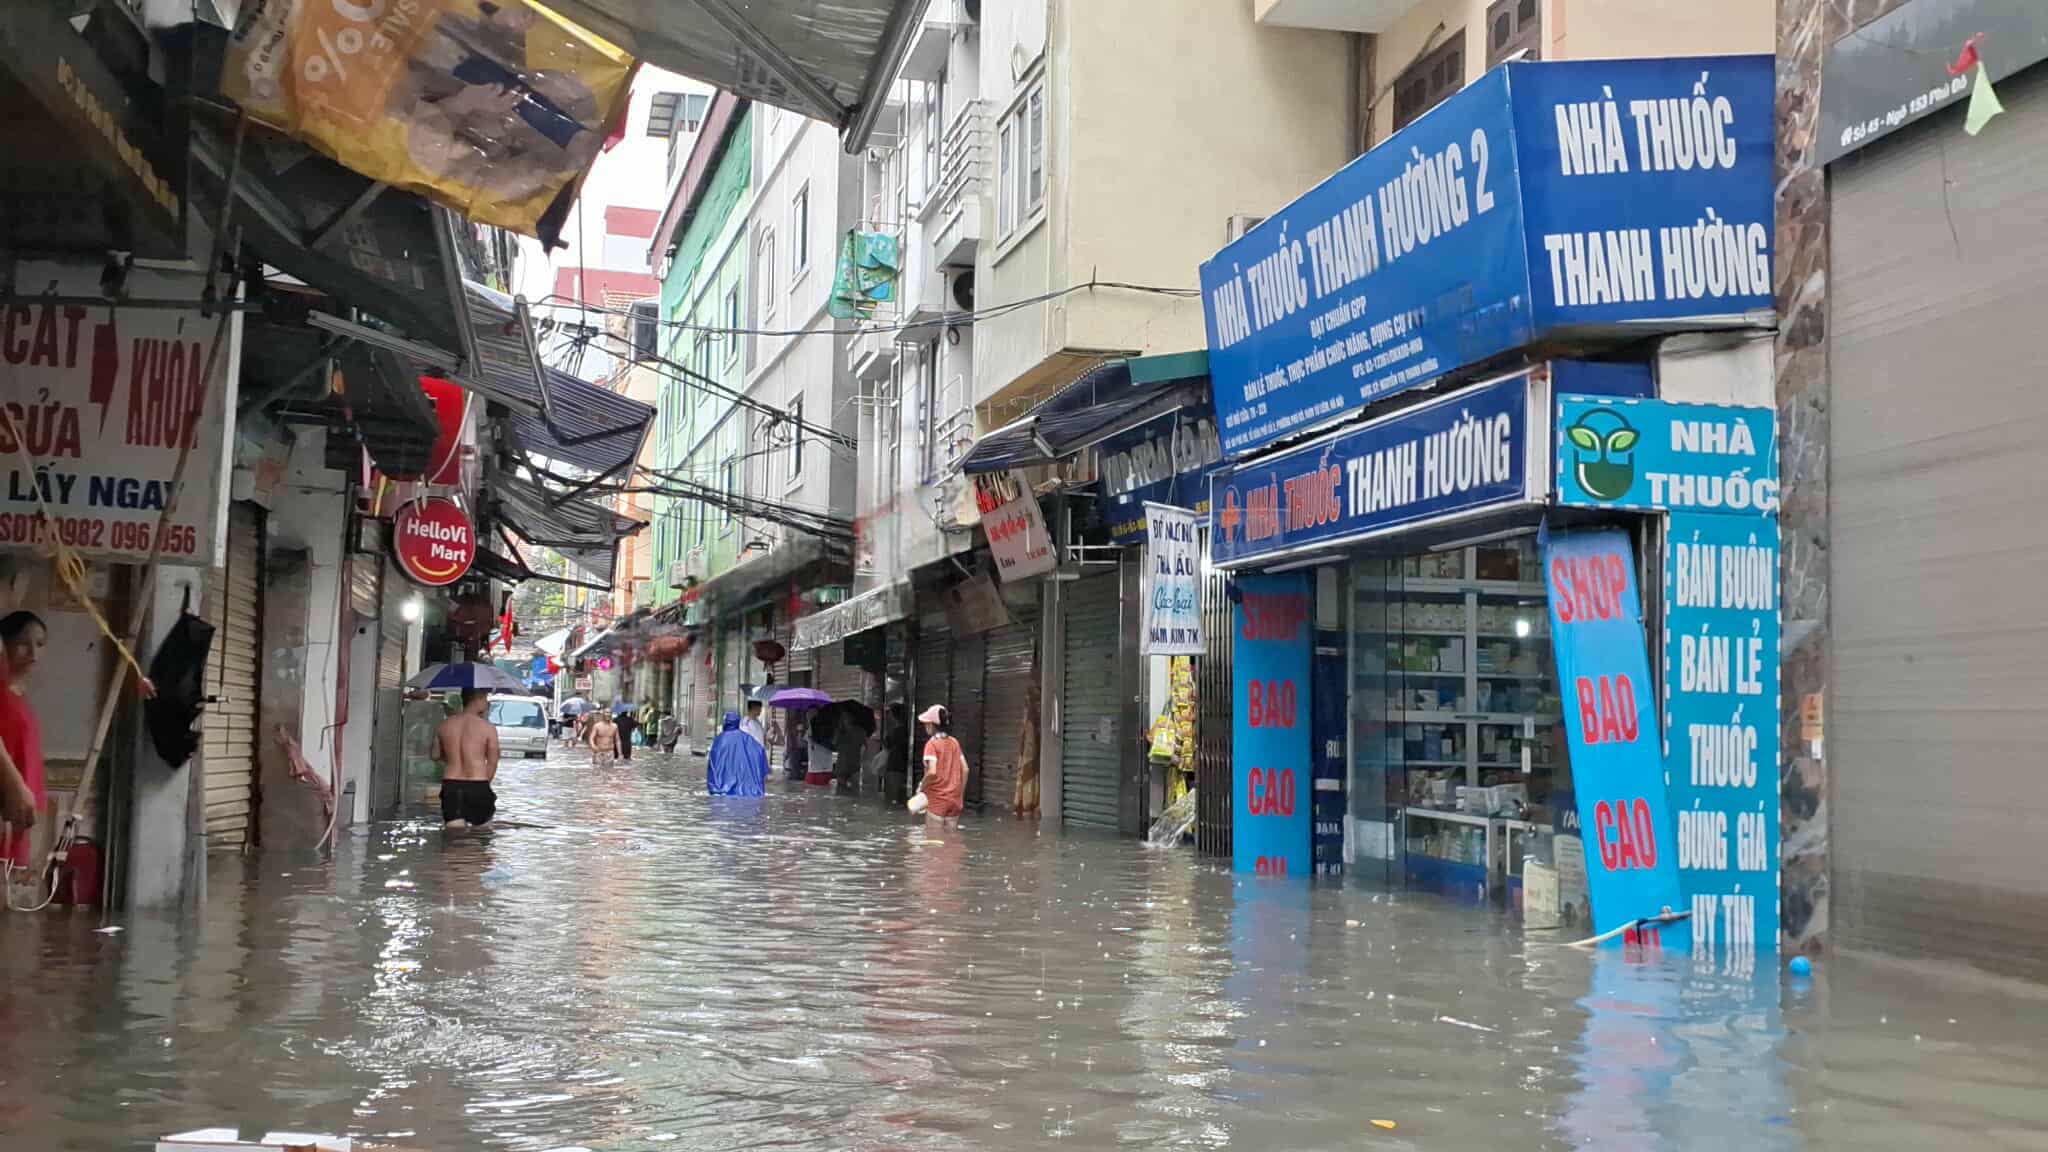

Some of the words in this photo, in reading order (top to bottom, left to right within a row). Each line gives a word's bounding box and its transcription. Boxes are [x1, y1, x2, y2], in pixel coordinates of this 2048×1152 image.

[1555, 85, 1629, 176] NHÀ
[1630, 71, 1737, 172] THUỐC
[1213, 262, 1251, 350] NHÀ
[1247, 219, 1308, 331] THUỐC
[1306, 194, 1380, 299] THANH
[1379, 142, 1470, 262] HƯỜNG
[1471, 127, 1495, 215] 2
[1544, 228, 1656, 307] THANH
[1660, 206, 1771, 300] HƯỜNG
[1350, 296, 1367, 319] GPP
[3, 280, 88, 369] CẮT
[126, 316, 202, 450] KHÓA
[0, 387, 81, 458] SỬA
[1670, 417, 1756, 456] NHÀ
[8, 462, 77, 504] LẤY
[88, 476, 184, 511] NGAY
[1246, 472, 1281, 543] NHÀ
[1284, 448, 1342, 533] THUỐC
[1346, 440, 1418, 517] THANH
[1423, 408, 1511, 499] HƯỜNG
[1645, 467, 1778, 510] THUỐC
[111, 521, 150, 551] 096
[407, 517, 467, 544] HelloVi
[431, 543, 466, 563] Mart
[1551, 553, 1628, 624] SHOP
[1676, 530, 1716, 608] BÁN
[1721, 532, 1773, 611] BUÔN
[1680, 623, 1729, 693] BÁN
[1736, 618, 1763, 695] LẺ
[1248, 679, 1297, 729] BAO
[1576, 673, 1639, 744] BAO
[1688, 703, 1757, 788] THUỐC
[1247, 767, 1297, 817] CAO
[1594, 797, 1658, 872] CAO
[1678, 798, 1728, 870] ĐÚNG
[1737, 800, 1768, 872] GIÁ
[1691, 894, 1717, 947] UY
[1722, 884, 1755, 947] TÍN
